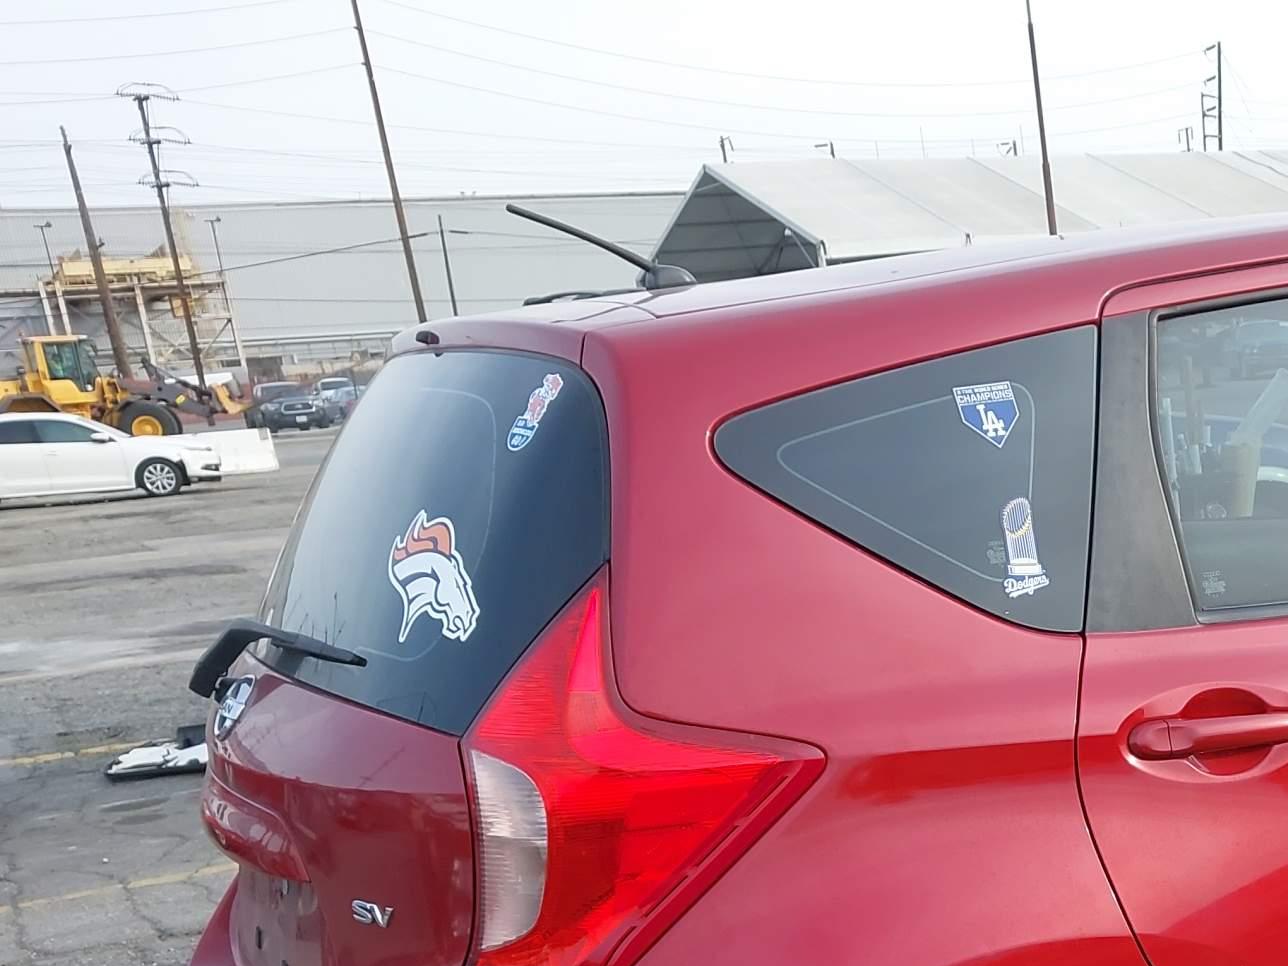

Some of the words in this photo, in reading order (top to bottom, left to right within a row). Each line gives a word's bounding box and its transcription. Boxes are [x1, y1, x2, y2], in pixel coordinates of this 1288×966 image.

[957, 389, 1012, 404] CHAMPIONS
[976, 404, 1006, 437] LA
[1004, 575, 1049, 598] Dodgers
[352, 900, 394, 928] SV
